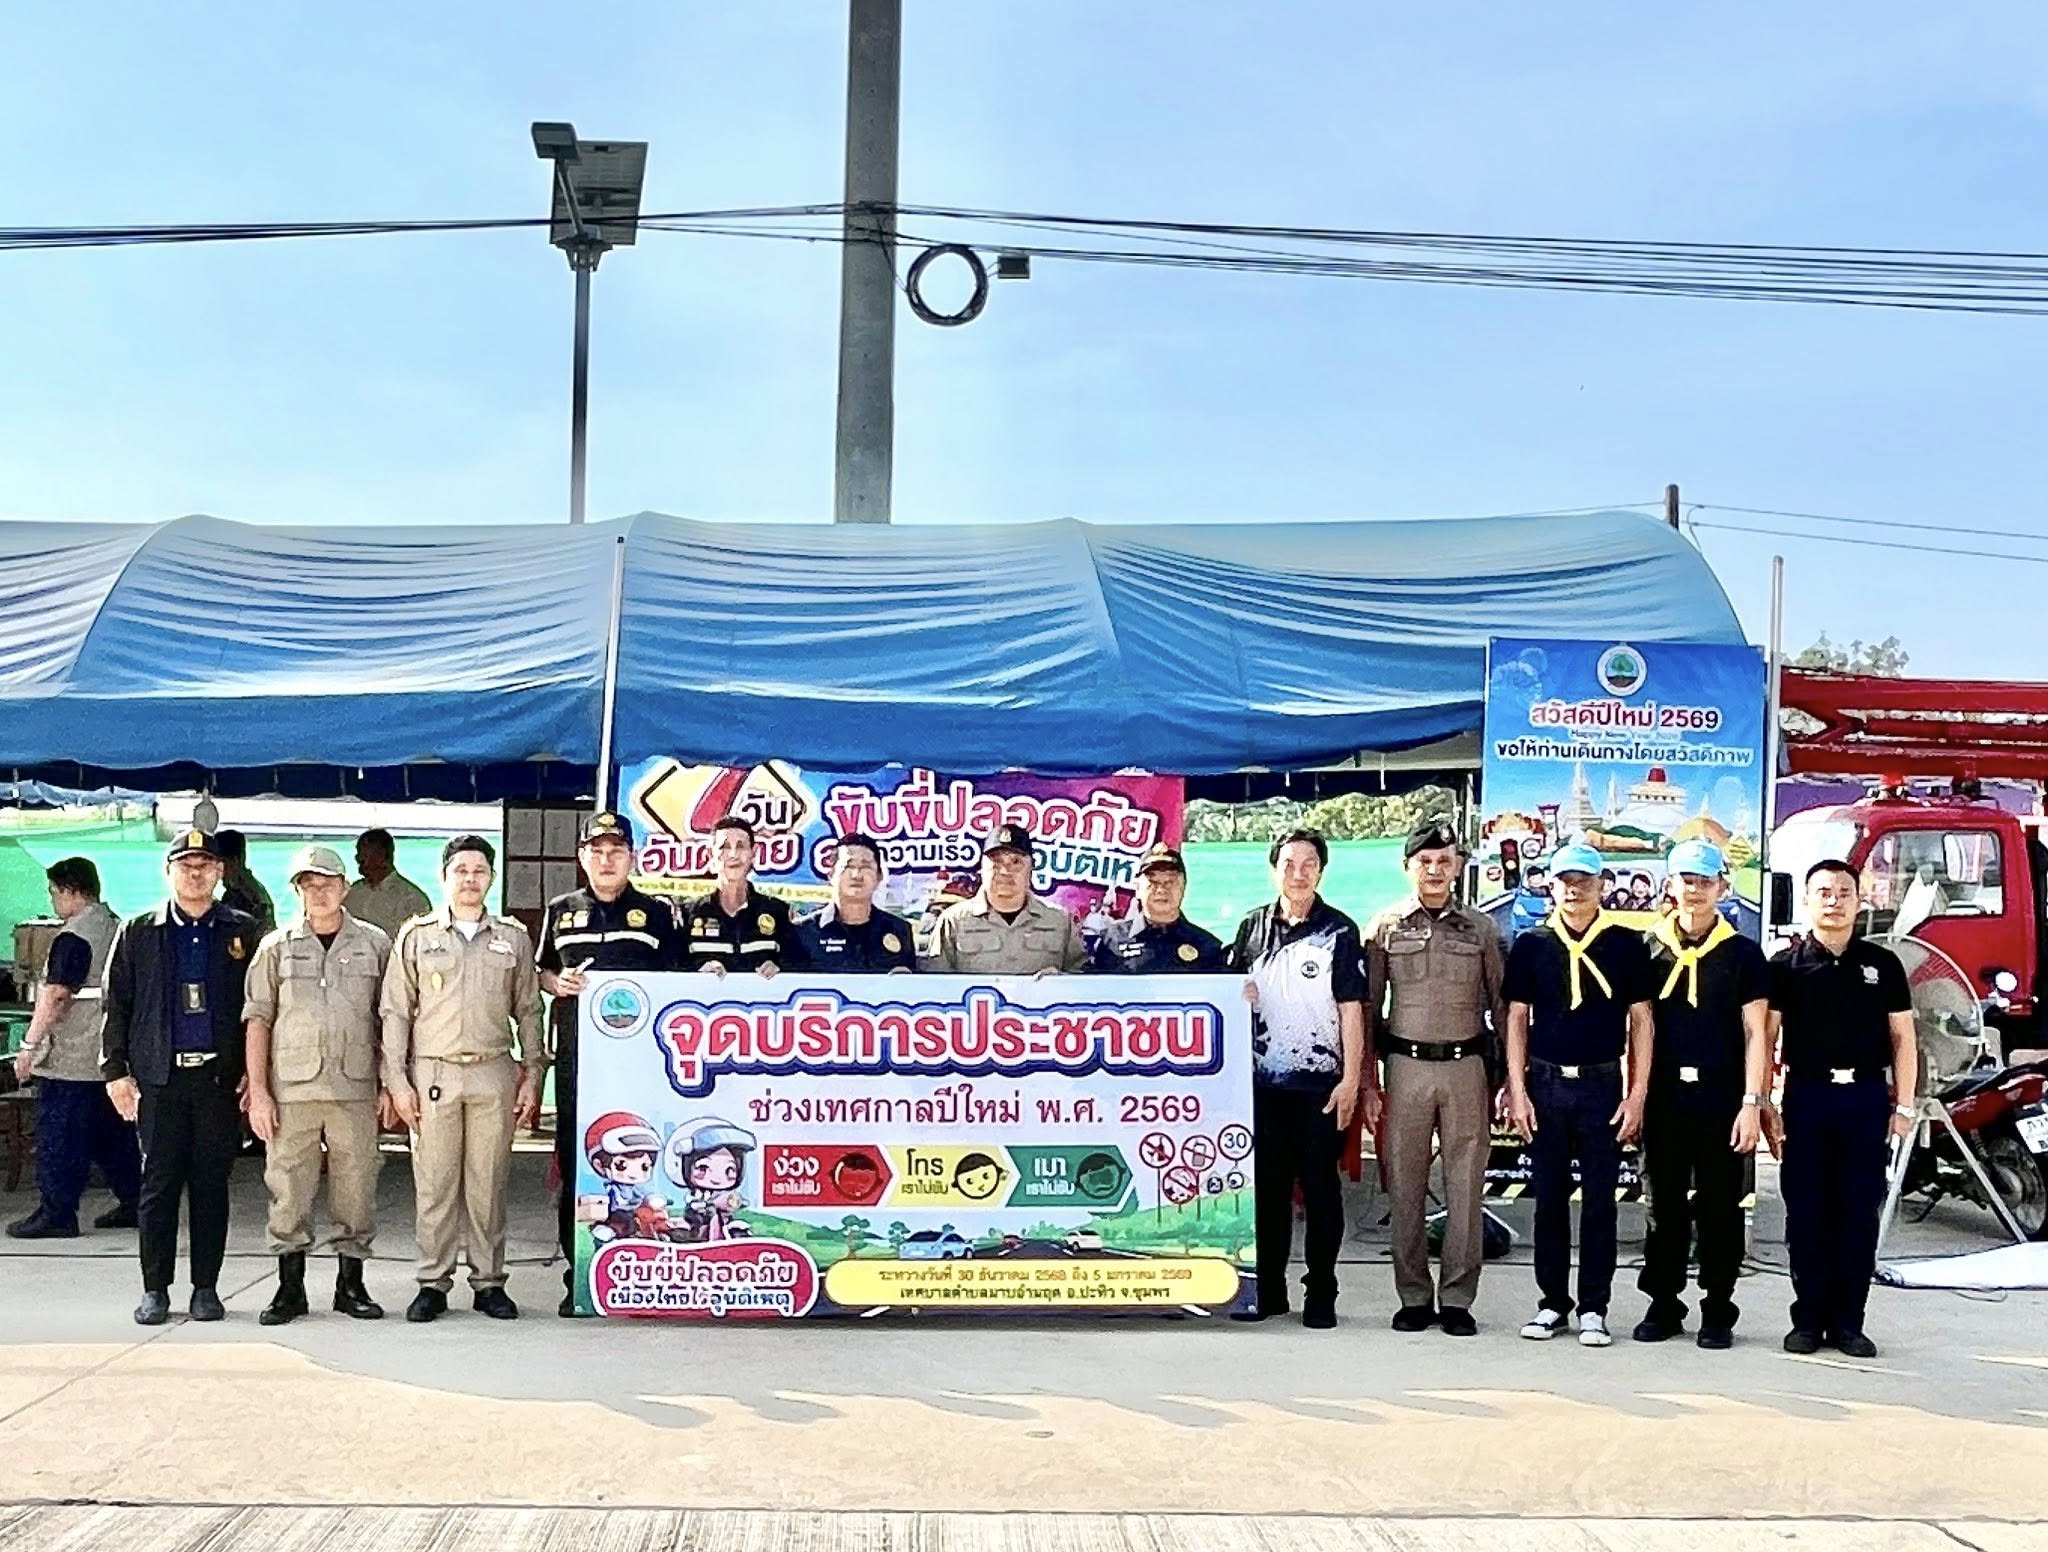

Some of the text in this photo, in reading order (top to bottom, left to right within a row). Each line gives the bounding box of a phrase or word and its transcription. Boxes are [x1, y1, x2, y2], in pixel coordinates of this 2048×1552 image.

[1531, 701, 1719, 729] สวัสดีปีใหม่ 2569
[1497, 737, 1750, 763] ขอให้ท่านเดินทางโดยสวัสดิภาพ
[742, 793, 788, 826] วัน
[831, 769, 1151, 849] ขับขี่ปลอดภัย
[667, 998, 1205, 1080] จุดบริการประชาชน
[748, 1083, 1201, 1124] ช่วงเทศกาลปีใหม่ พ.ศ. 2569
[1223, 1132, 1248, 1150] 30
[773, 1148, 820, 1177] ง่วง
[906, 1148, 945, 1177] โทร
[1034, 1156, 1068, 1178] เมา
[612, 1247, 794, 1284] ขับขี่ปลอดภัย
[958, 1269, 974, 1281] 30
[1093, 1269, 1101, 1281] 5
